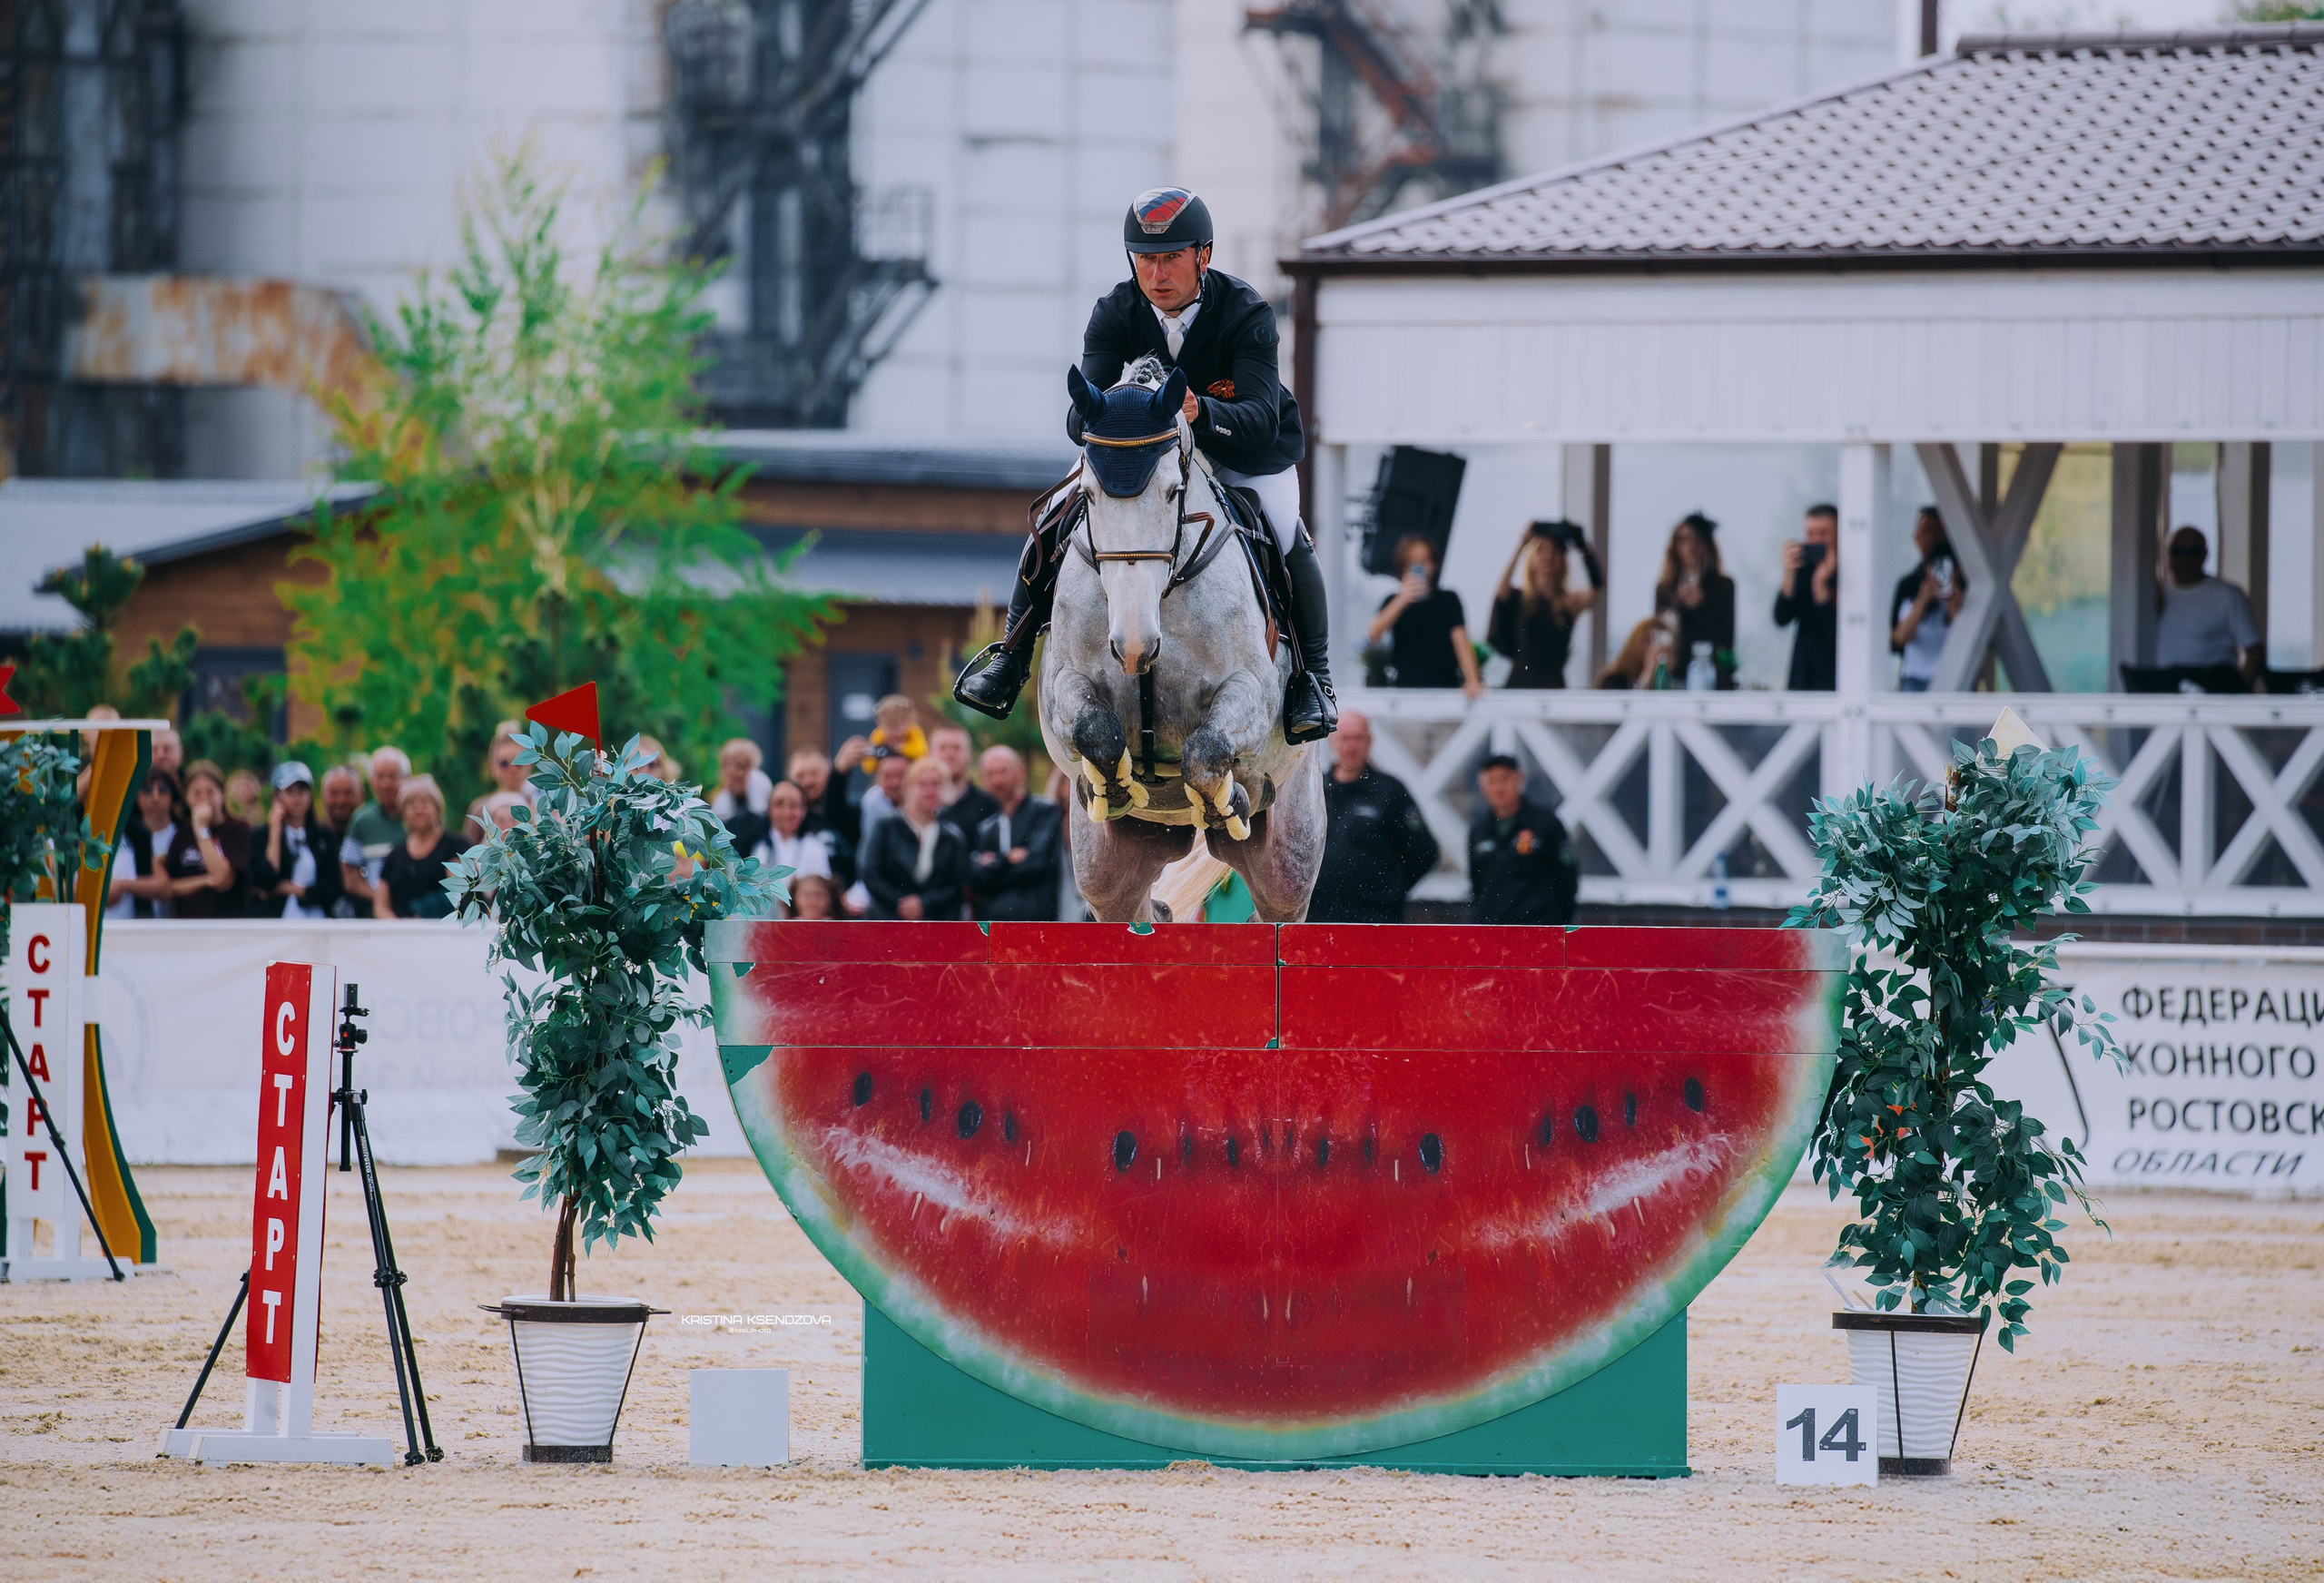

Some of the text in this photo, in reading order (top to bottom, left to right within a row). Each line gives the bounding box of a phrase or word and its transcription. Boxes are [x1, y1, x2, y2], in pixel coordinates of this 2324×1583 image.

[25, 933, 51, 1192] СТАРТ
[2124, 1042, 2316, 1079] КОННОГО
[261, 1001, 296, 1344] СТАРТ
[2112, 1147, 2304, 1176] ОБЛАСТИ
[1786, 1407, 1866, 1461] 14
